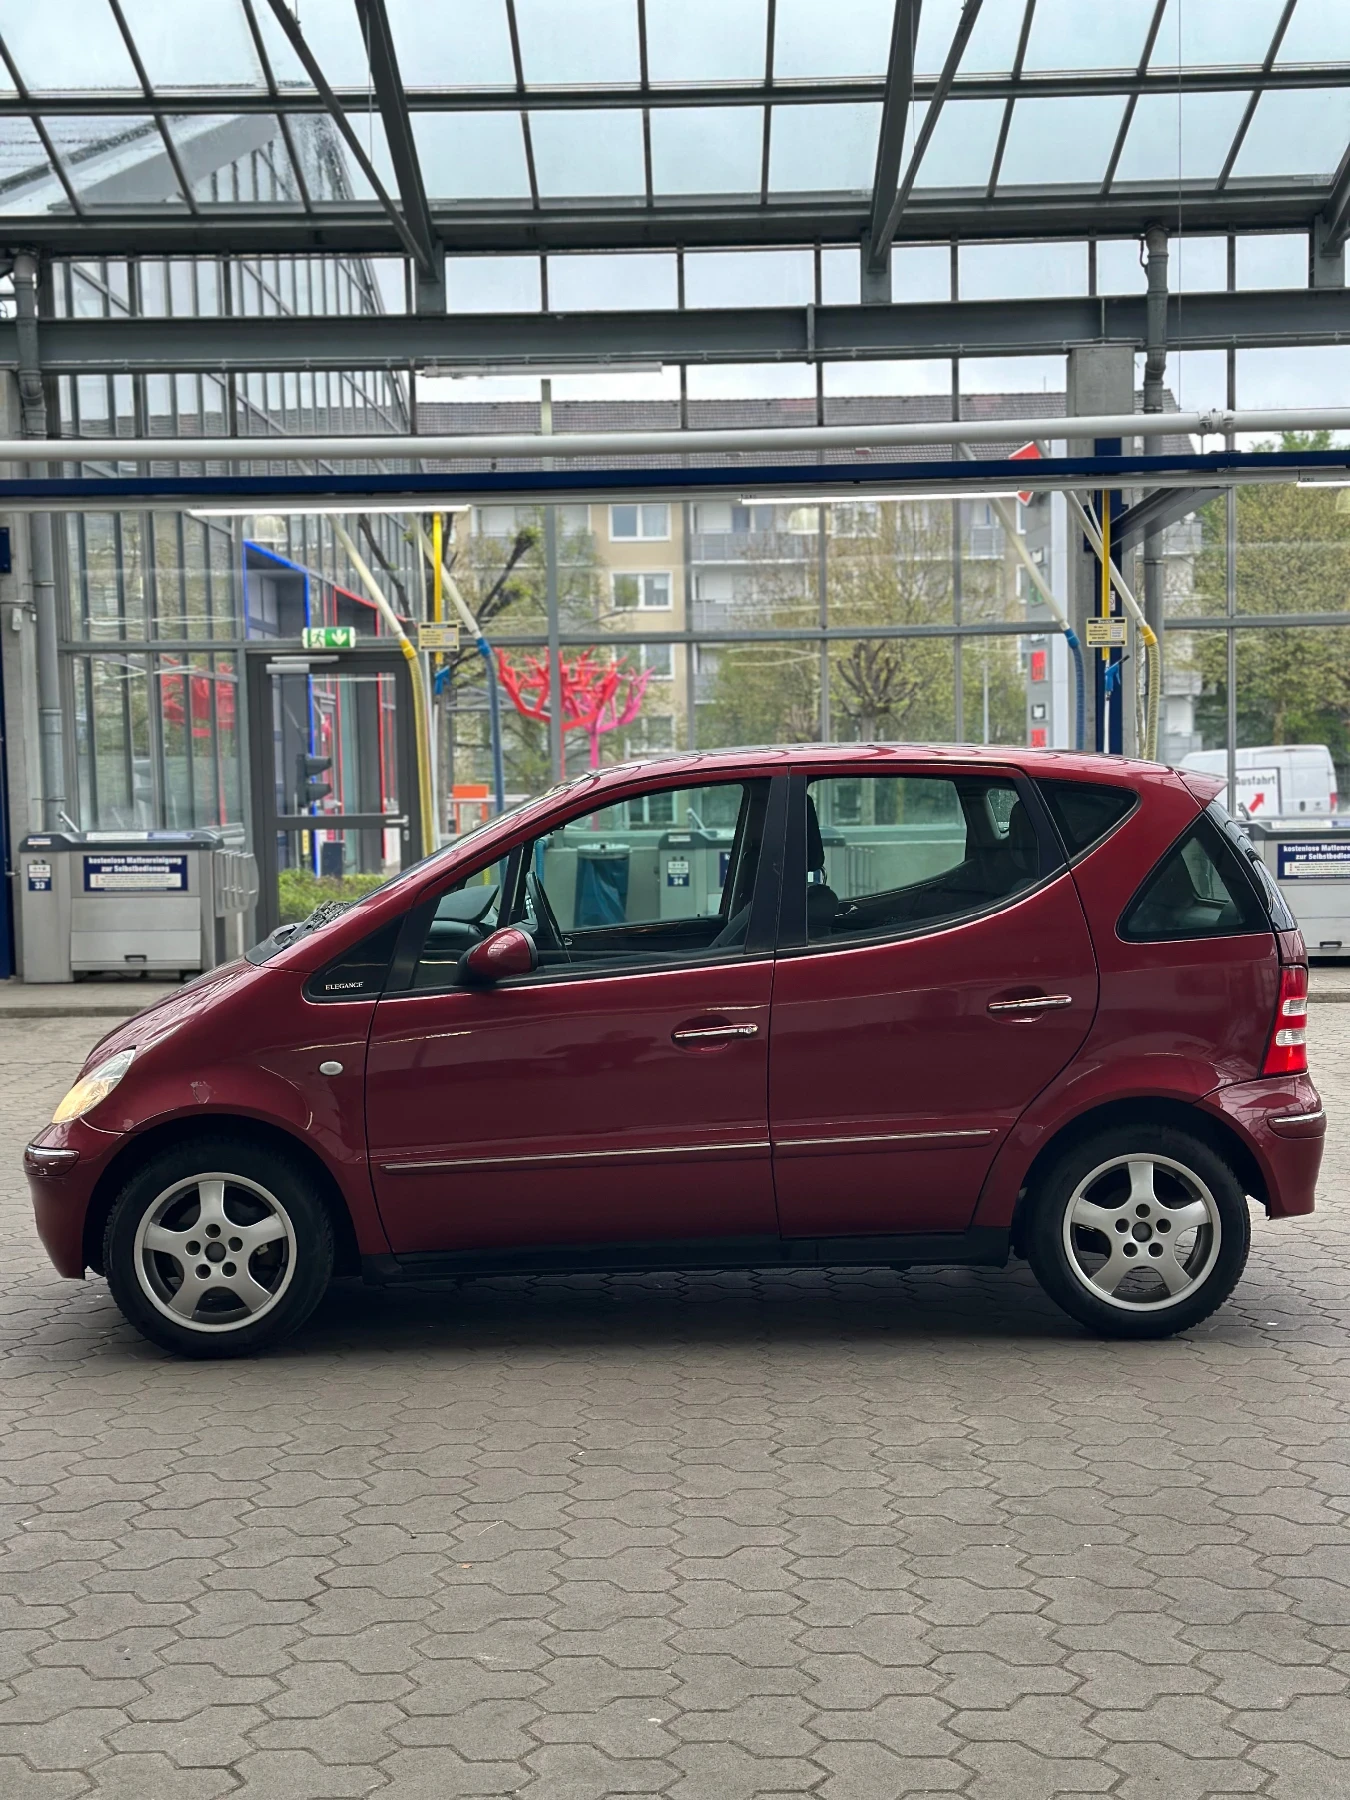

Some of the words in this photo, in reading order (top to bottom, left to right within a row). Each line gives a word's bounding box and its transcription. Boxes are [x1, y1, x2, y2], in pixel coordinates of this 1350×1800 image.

[126, 857, 182, 865] Mattenreinigung
[113, 865, 170, 873] Selbstbedienung
[325, 981, 364, 990] ELEGANCE
